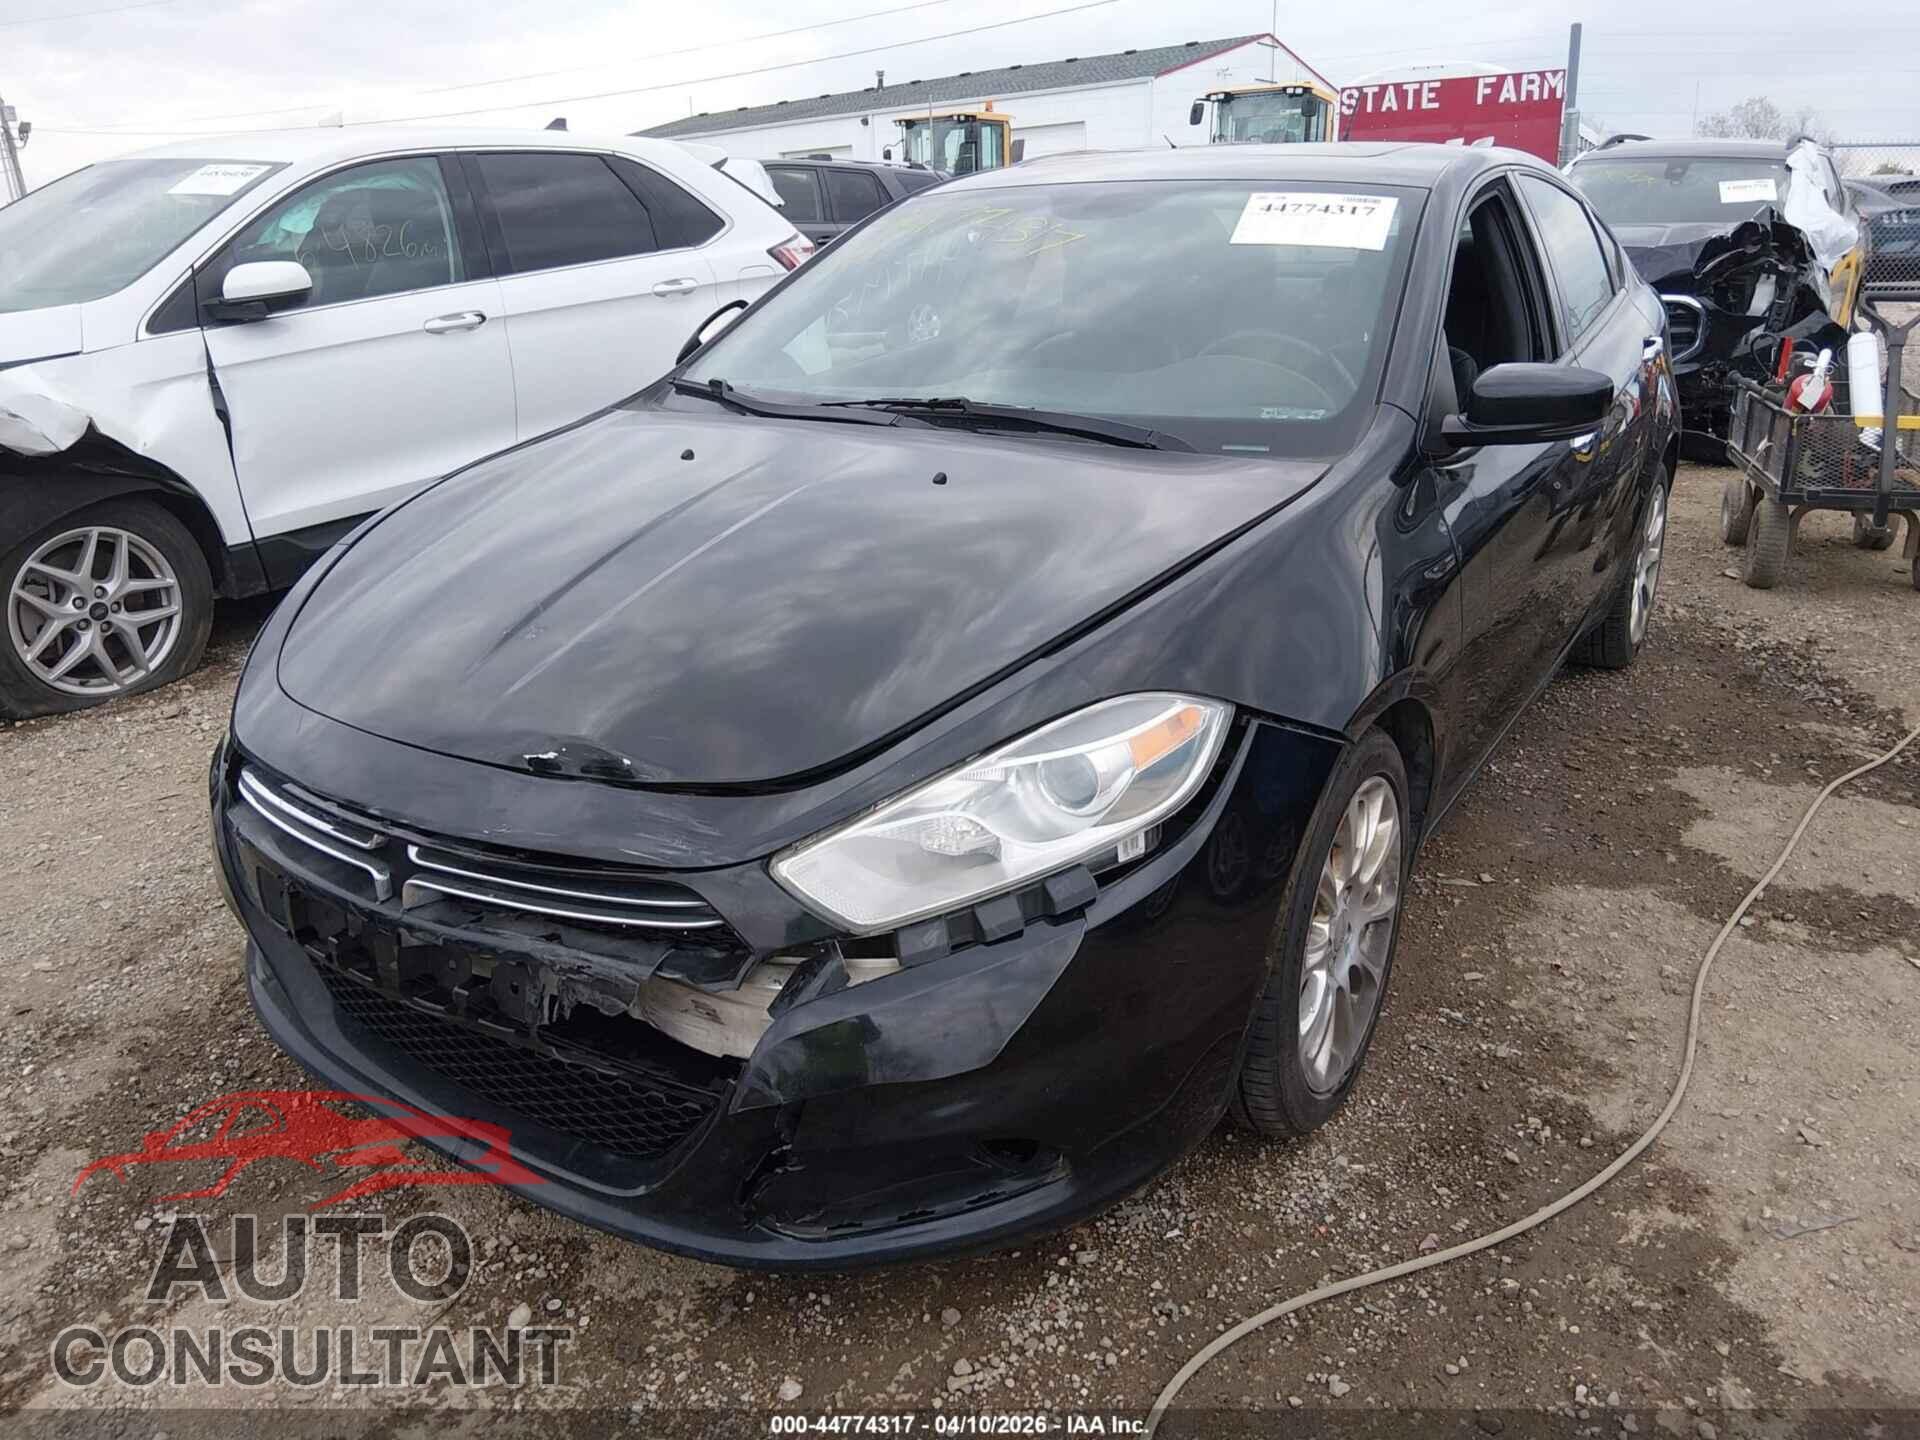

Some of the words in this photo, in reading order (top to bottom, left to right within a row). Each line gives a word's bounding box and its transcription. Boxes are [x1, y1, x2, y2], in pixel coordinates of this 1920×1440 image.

[1340, 81, 1442, 116] STATE
[1475, 71, 1564, 106] FARM
[1259, 202, 1377, 217] 44774317
